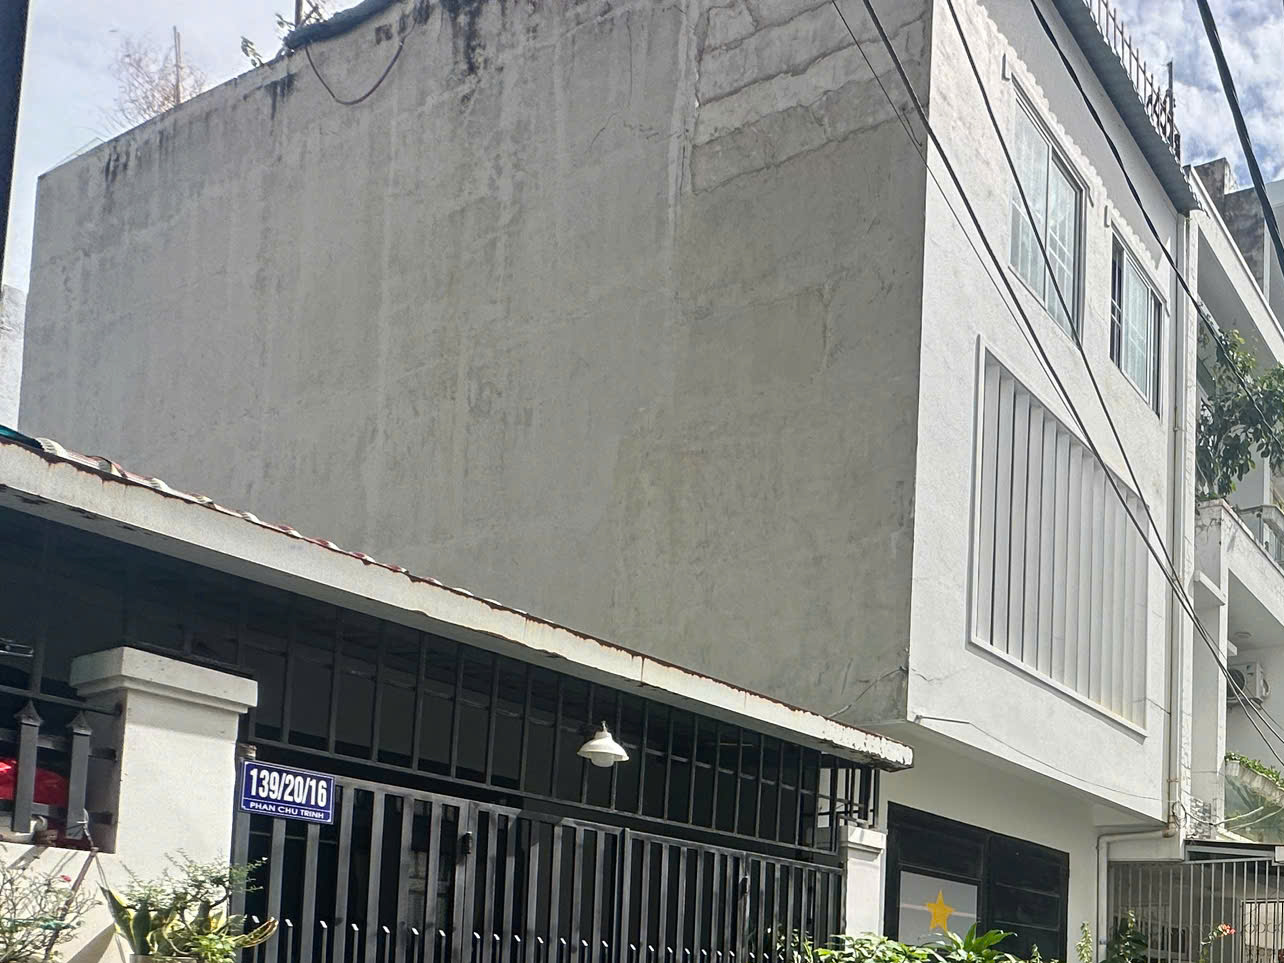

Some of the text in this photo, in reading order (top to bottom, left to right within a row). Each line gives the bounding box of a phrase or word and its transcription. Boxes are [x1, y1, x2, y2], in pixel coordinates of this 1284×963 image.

[250, 768, 327, 808] 139/20/16
[249, 801, 325, 819] PHAN CHU TRINH
